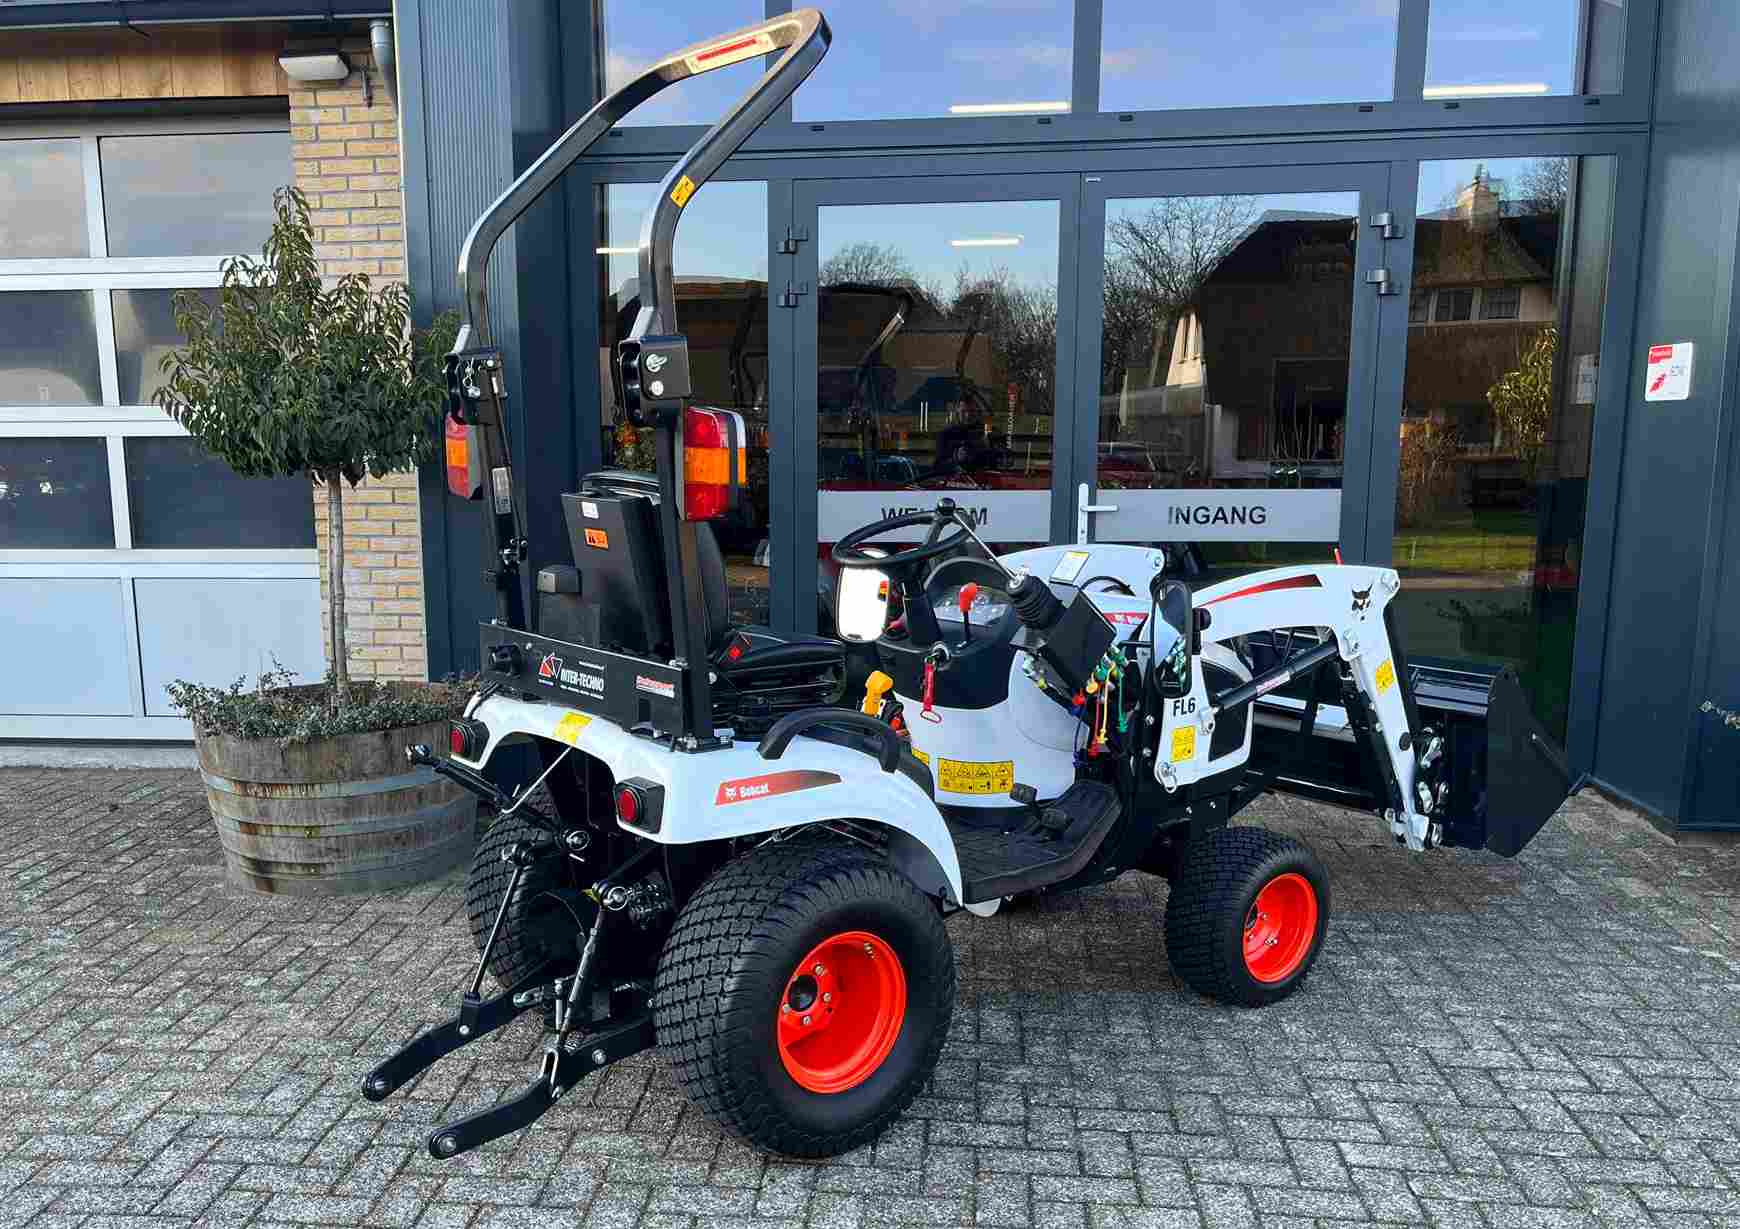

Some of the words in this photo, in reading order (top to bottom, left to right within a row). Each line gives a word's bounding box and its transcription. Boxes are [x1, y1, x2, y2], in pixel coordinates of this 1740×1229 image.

[881, 507, 988, 525] WEM
[1168, 505, 1267, 525] INGANG
[560, 668, 604, 692] INTER-TECHNO
[1173, 697, 1196, 716] FL6
[739, 783, 769, 798] Bobcat
